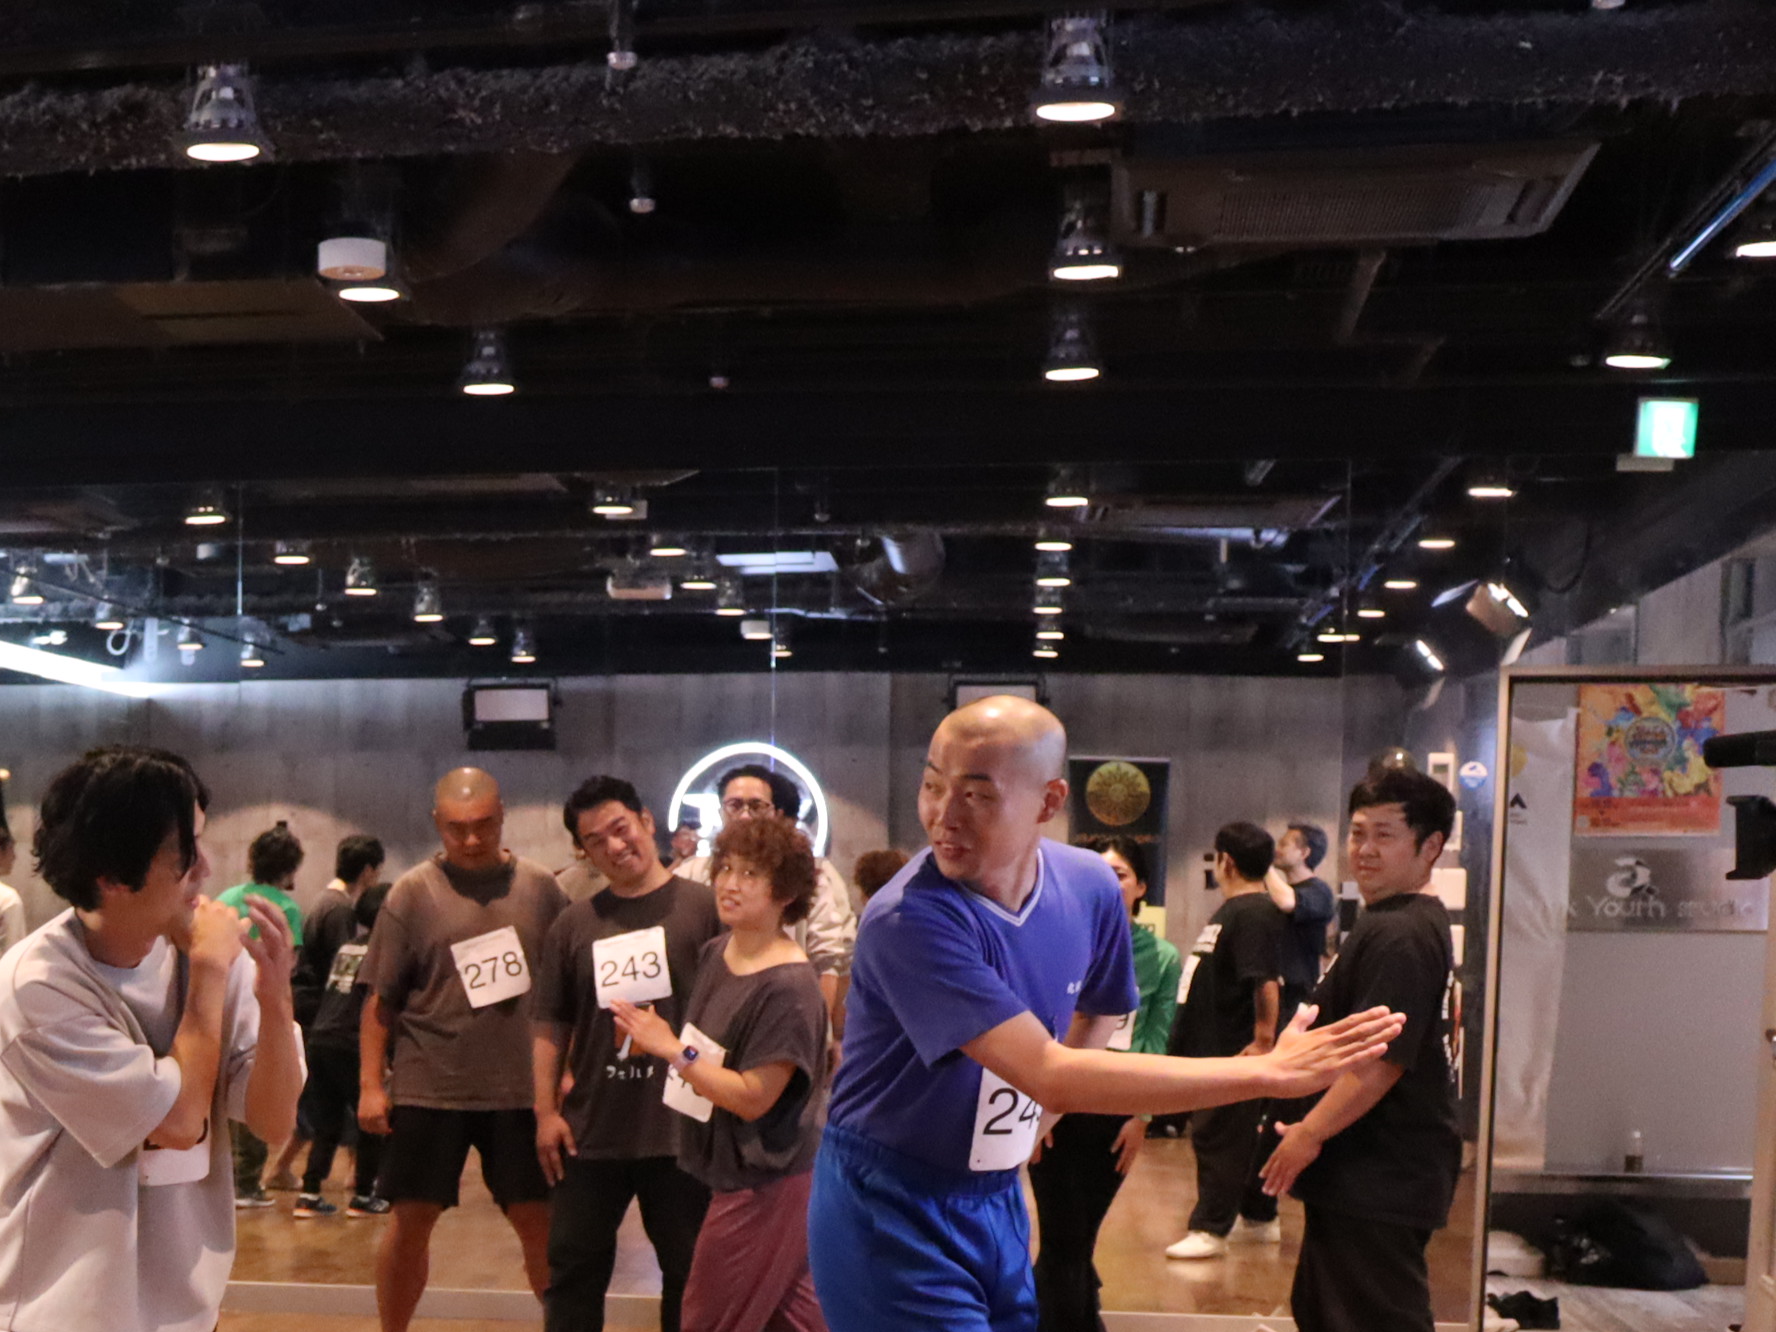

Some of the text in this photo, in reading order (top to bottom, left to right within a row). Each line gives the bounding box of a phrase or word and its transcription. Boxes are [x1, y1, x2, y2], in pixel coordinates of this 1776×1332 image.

[464, 950, 523, 990] 278
[600, 951, 662, 988] 243
[982, 1087, 1041, 1136] 24
